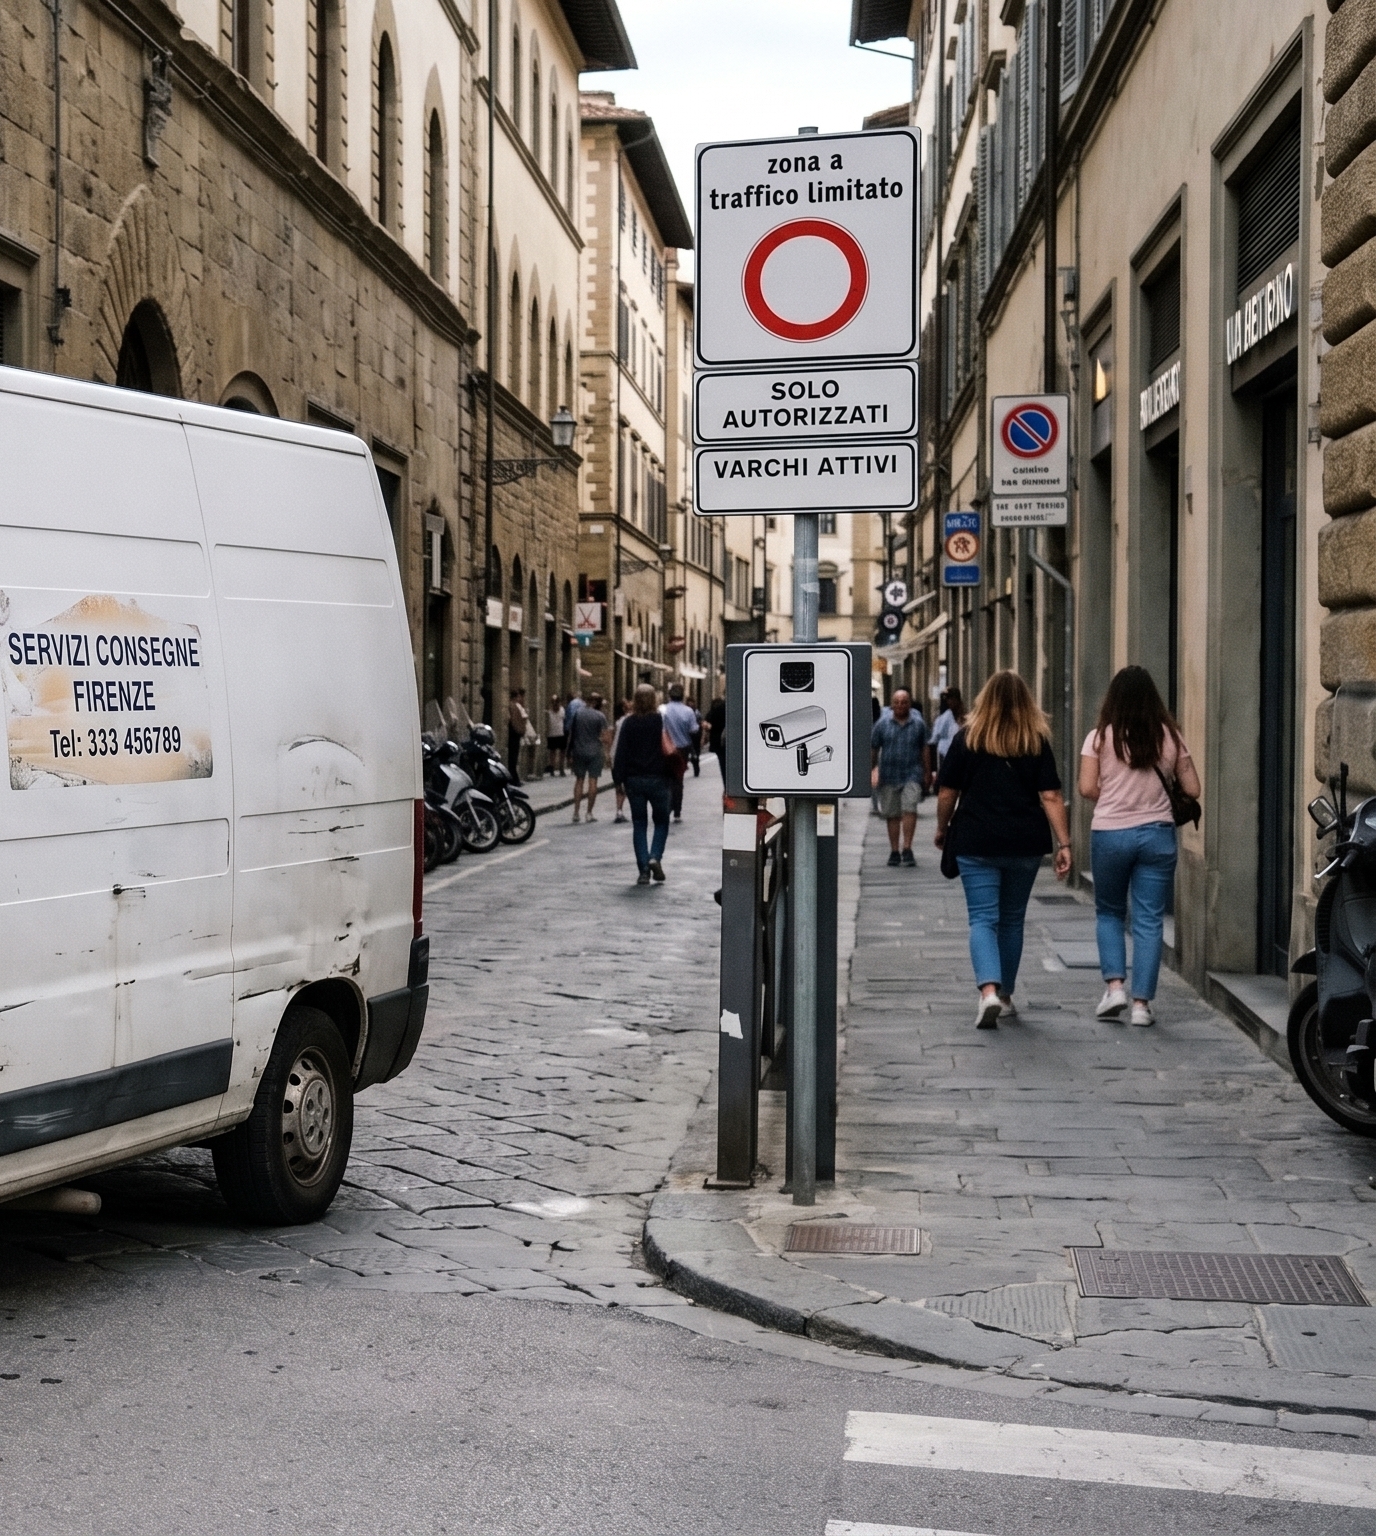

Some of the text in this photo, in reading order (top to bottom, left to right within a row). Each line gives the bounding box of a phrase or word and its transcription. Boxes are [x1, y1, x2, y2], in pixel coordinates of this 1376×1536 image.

[767, 153, 844, 175] zona a
[709, 176, 903, 211] traffico limitato
[770, 379, 840, 401] SOLO
[722, 404, 889, 429] AUTORIZZATI
[713, 454, 897, 479] VARCHI ATTIVI
[8, 632, 200, 667] SERVIZI CONSEGNE
[73, 680, 156, 712] FIRENZE
[49, 725, 182, 758] Tel: 333 456789
